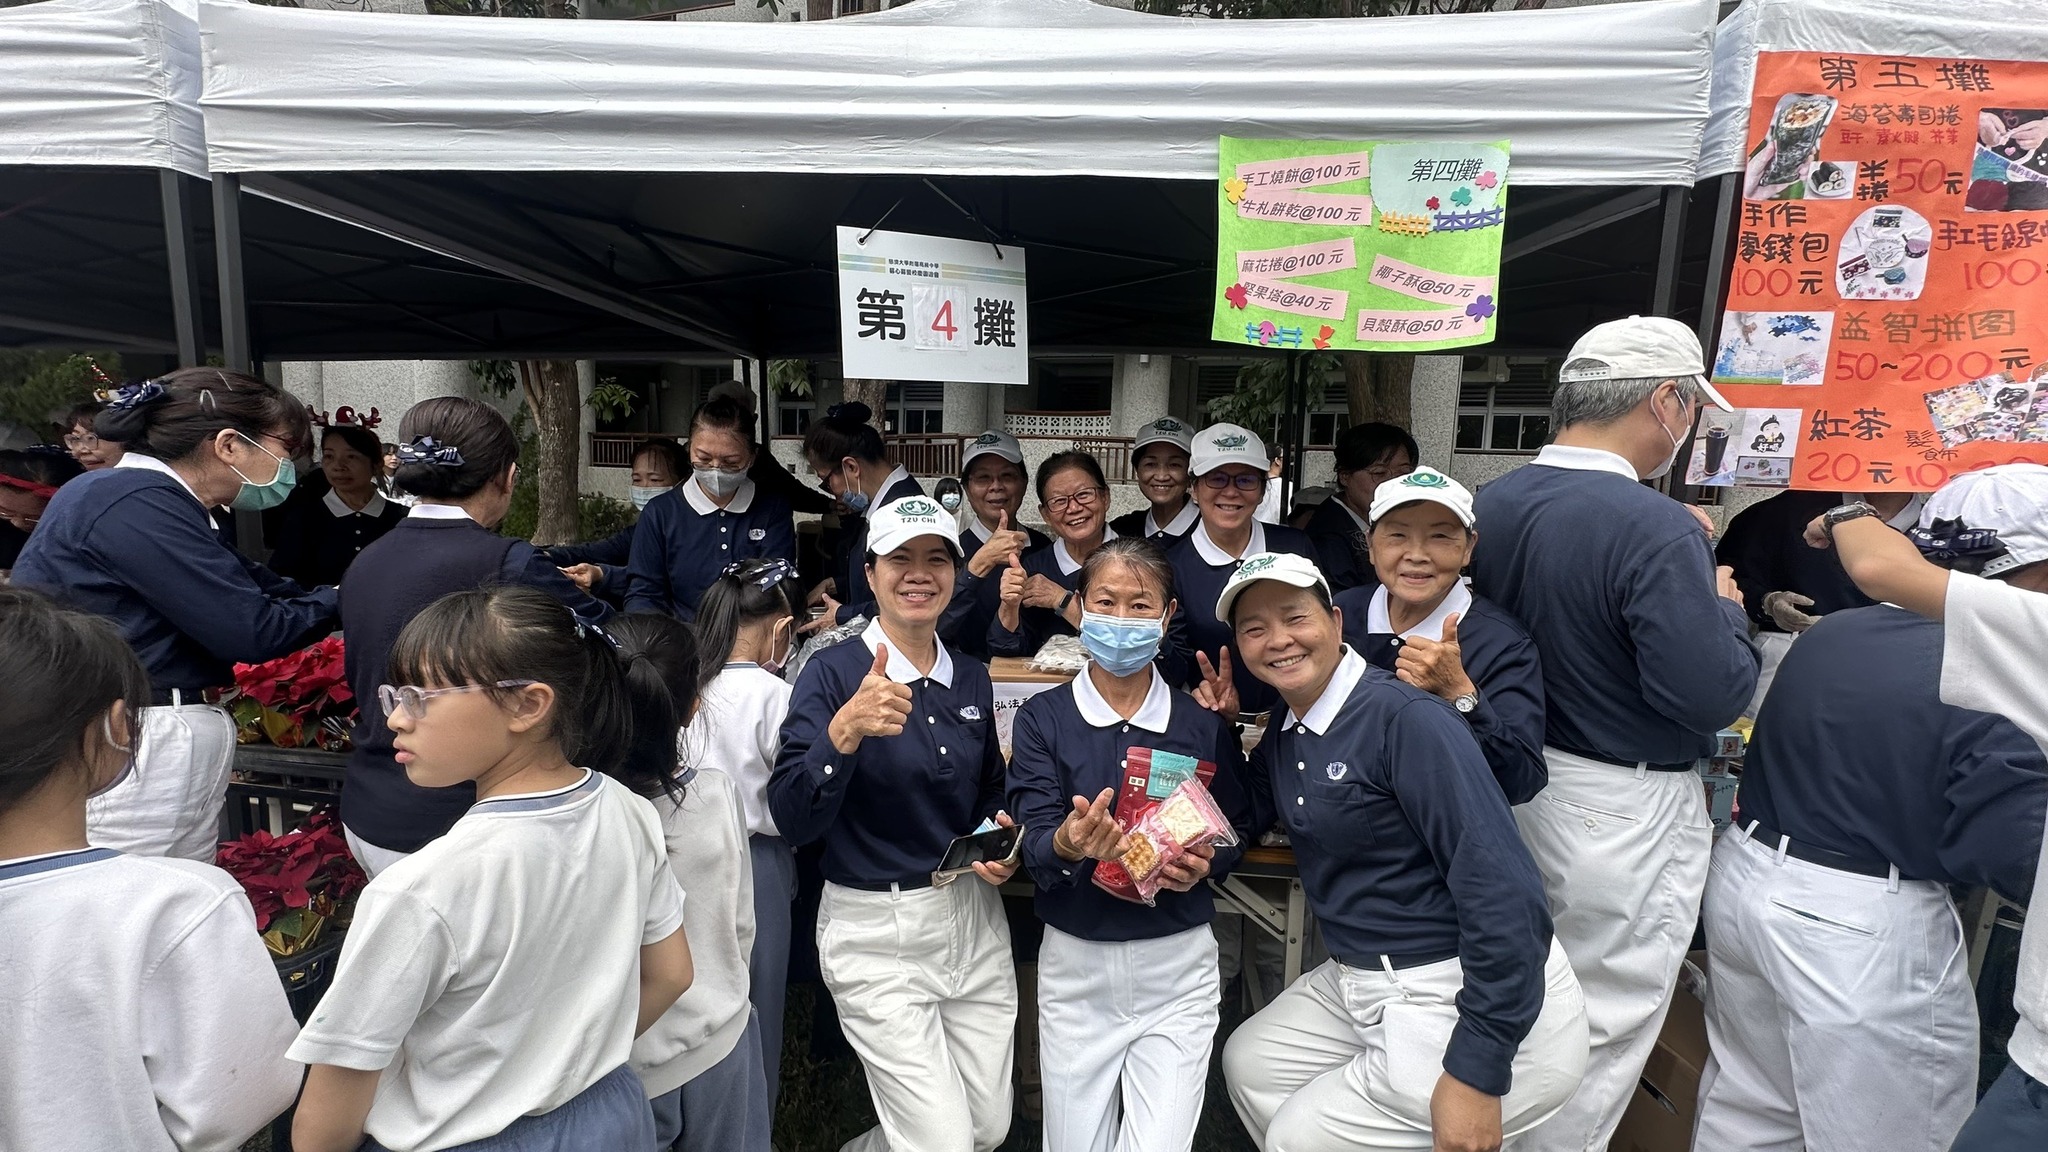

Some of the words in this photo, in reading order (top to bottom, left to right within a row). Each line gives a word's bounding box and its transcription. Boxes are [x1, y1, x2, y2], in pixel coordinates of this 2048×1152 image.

[1819, 57, 1994, 92] 第五攤
[1840, 103, 1963, 126] 海苔壽司捲
[1242, 164, 1341, 186] 手工燒餅@100
[1346, 160, 1361, 176] 元
[1408, 158, 1484, 182] 第四攤
[1242, 200, 1343, 220] 牛札餅乾@100
[1347, 210, 1362, 221] 元
[1745, 201, 1807, 228] 手作
[1241, 252, 1325, 273] 麻花捲@100
[1328, 248, 1344, 264] 元
[1740, 231, 1829, 264] 零錢包
[1375, 265, 1456, 294] 椰子酥@50
[1458, 283, 1475, 298] 元
[1964, 259, 2048, 290] 100
[1318, 295, 1334, 311] 元
[1446, 315, 1464, 330] 元
[1809, 407, 1891, 441] 紅茶
